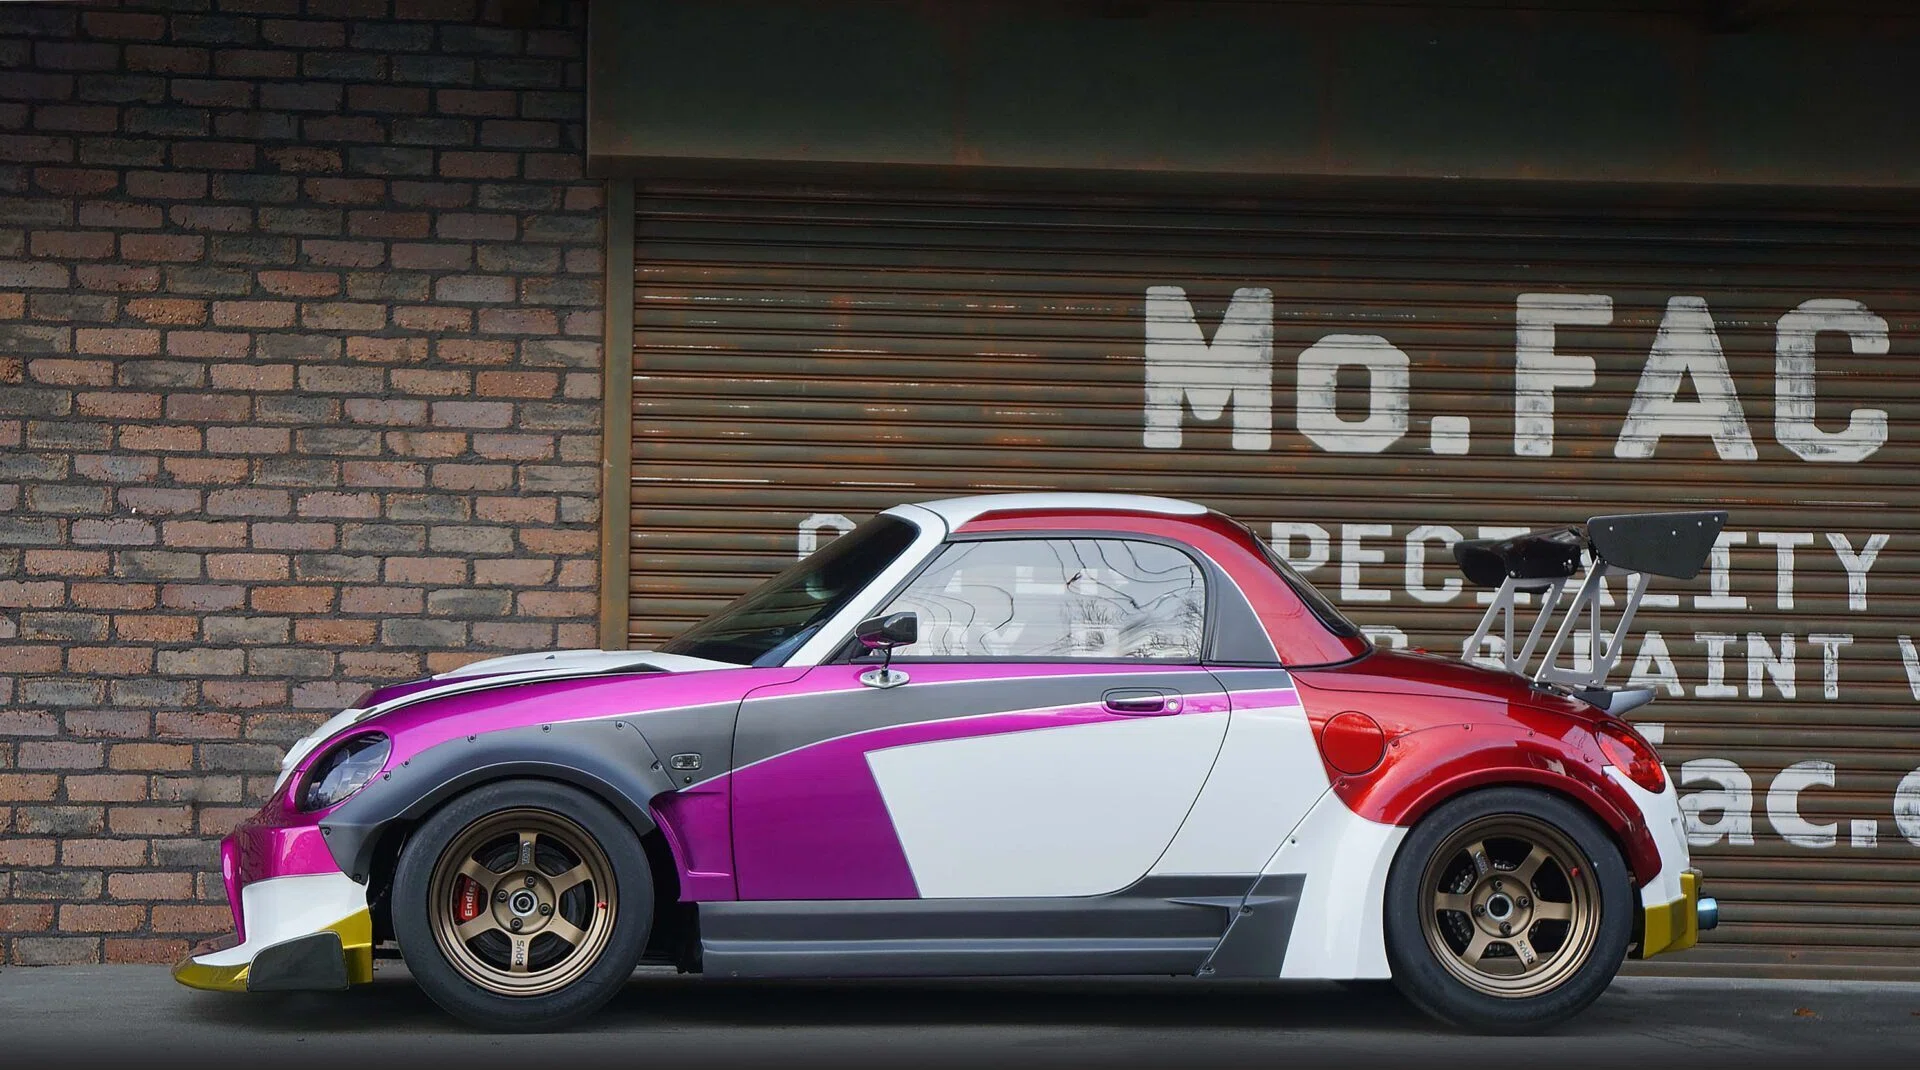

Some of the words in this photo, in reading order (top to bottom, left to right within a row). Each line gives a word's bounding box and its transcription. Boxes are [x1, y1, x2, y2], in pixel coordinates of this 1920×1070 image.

[1574, 629, 1854, 699] PAINT
[464, 880, 477, 917] Endles
[515, 940, 525, 966] RAYS
